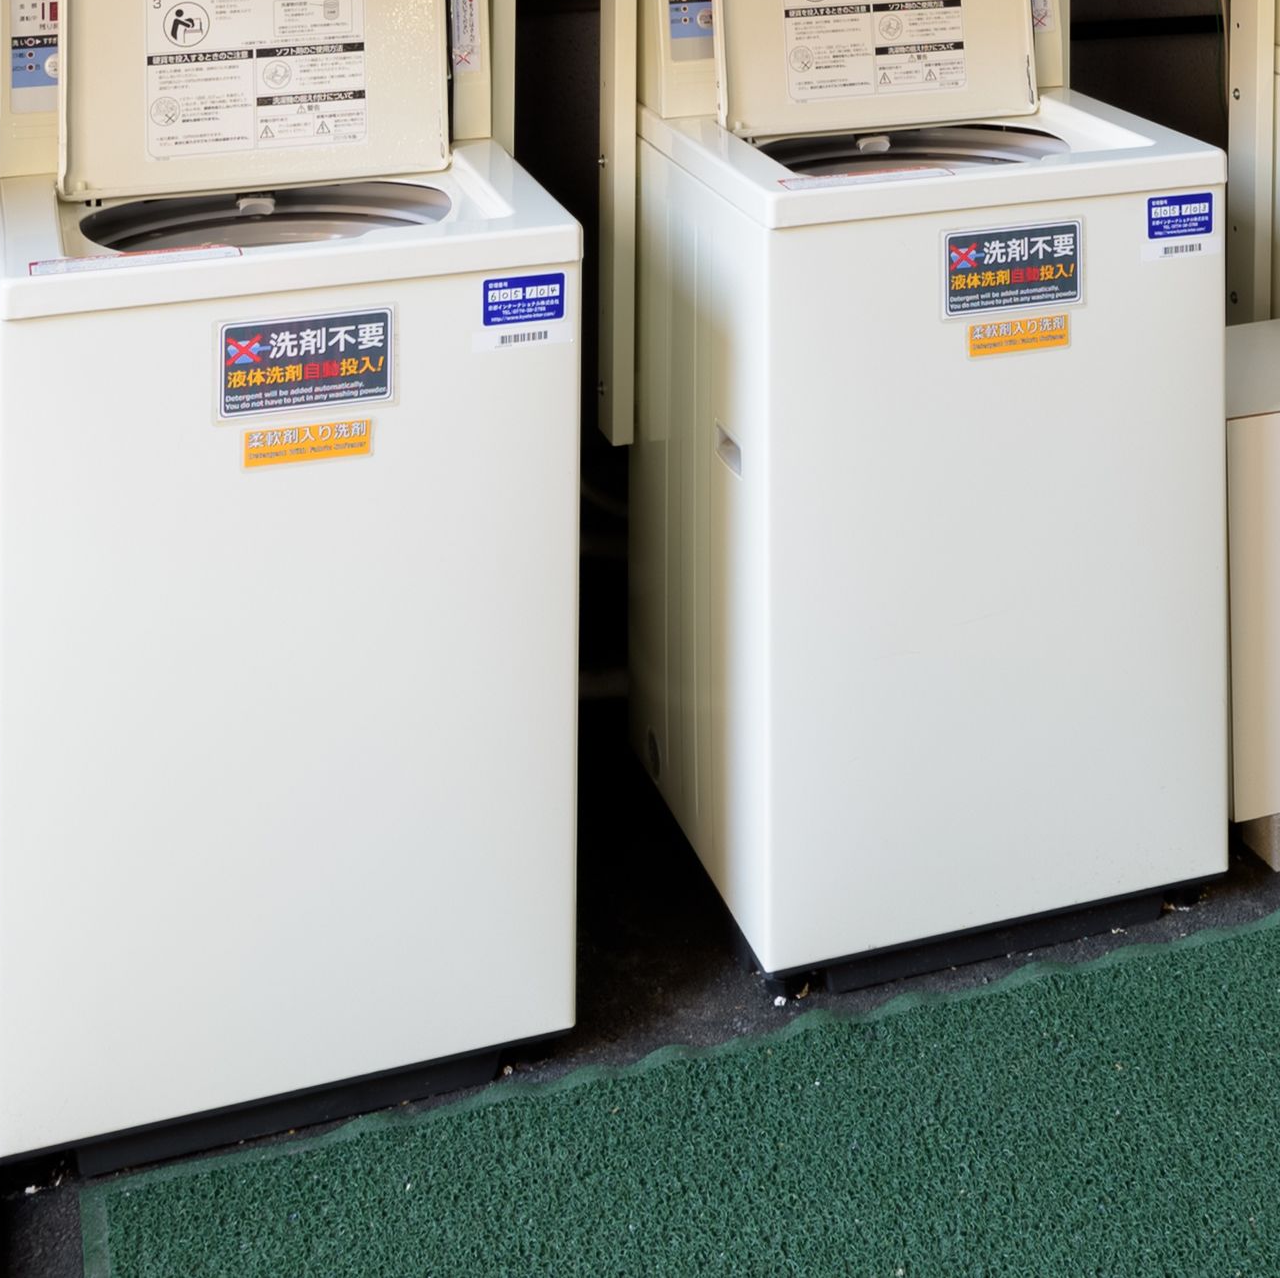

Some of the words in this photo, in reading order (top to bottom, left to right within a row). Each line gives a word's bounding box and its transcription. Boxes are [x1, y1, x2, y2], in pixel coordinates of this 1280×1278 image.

[983, 233, 1074, 264] 洗剤不要
[269, 322, 385, 359] 洗剤不要
[227, 356, 383, 388] 液体洗剤自動投入!
[249, 421, 366, 448] 柔軟剤入り洗剤
